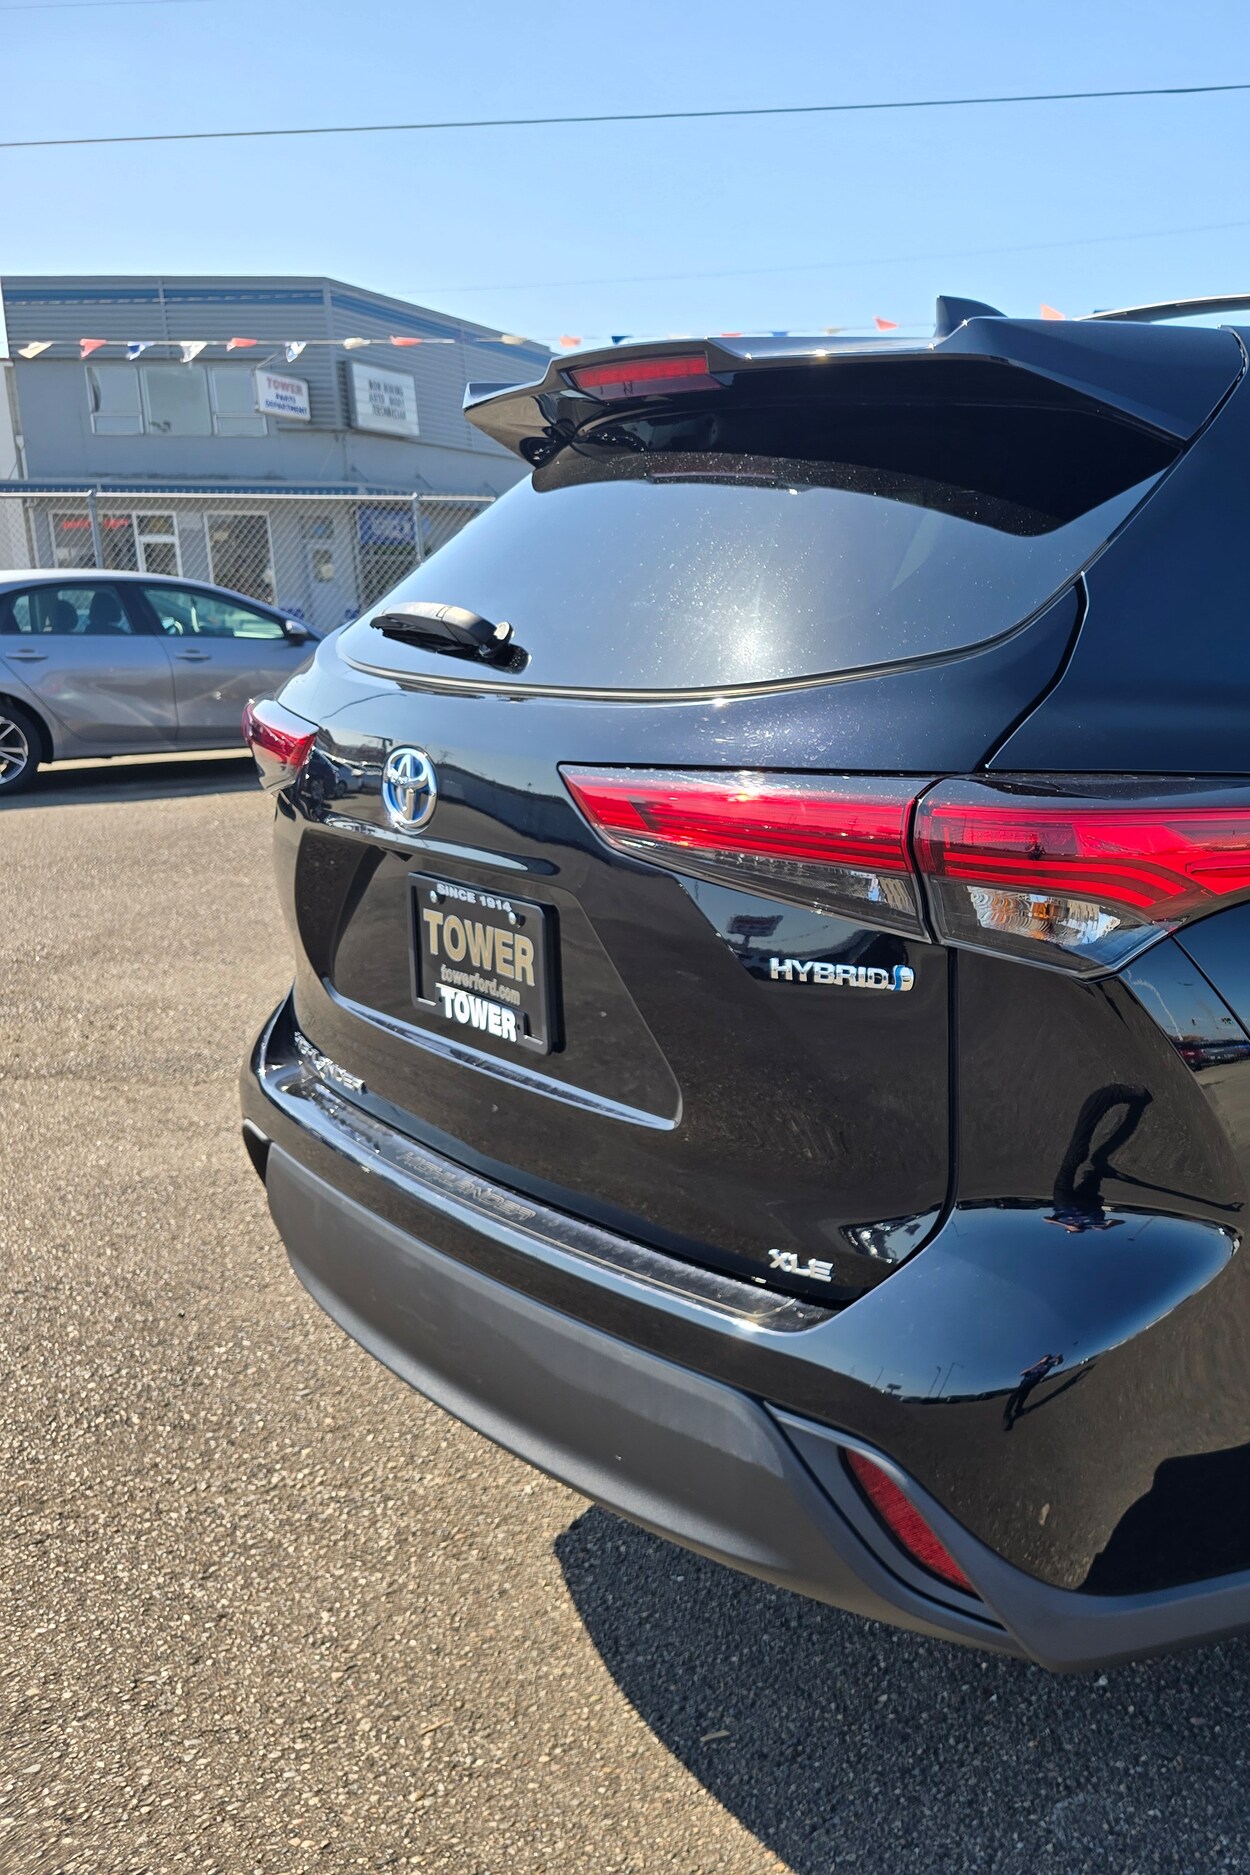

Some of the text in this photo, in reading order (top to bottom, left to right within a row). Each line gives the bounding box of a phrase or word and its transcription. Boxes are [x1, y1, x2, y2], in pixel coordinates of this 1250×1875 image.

[266, 376, 303, 396] TOWER
[436, 883, 512, 913] SINCE 1914
[423, 907, 535, 987] TOWER
[440, 964, 521, 1006] towerford.com
[769, 957, 889, 990] HYBRID
[440, 986, 517, 1043] TOWER
[768, 1248, 834, 1283] XLE
